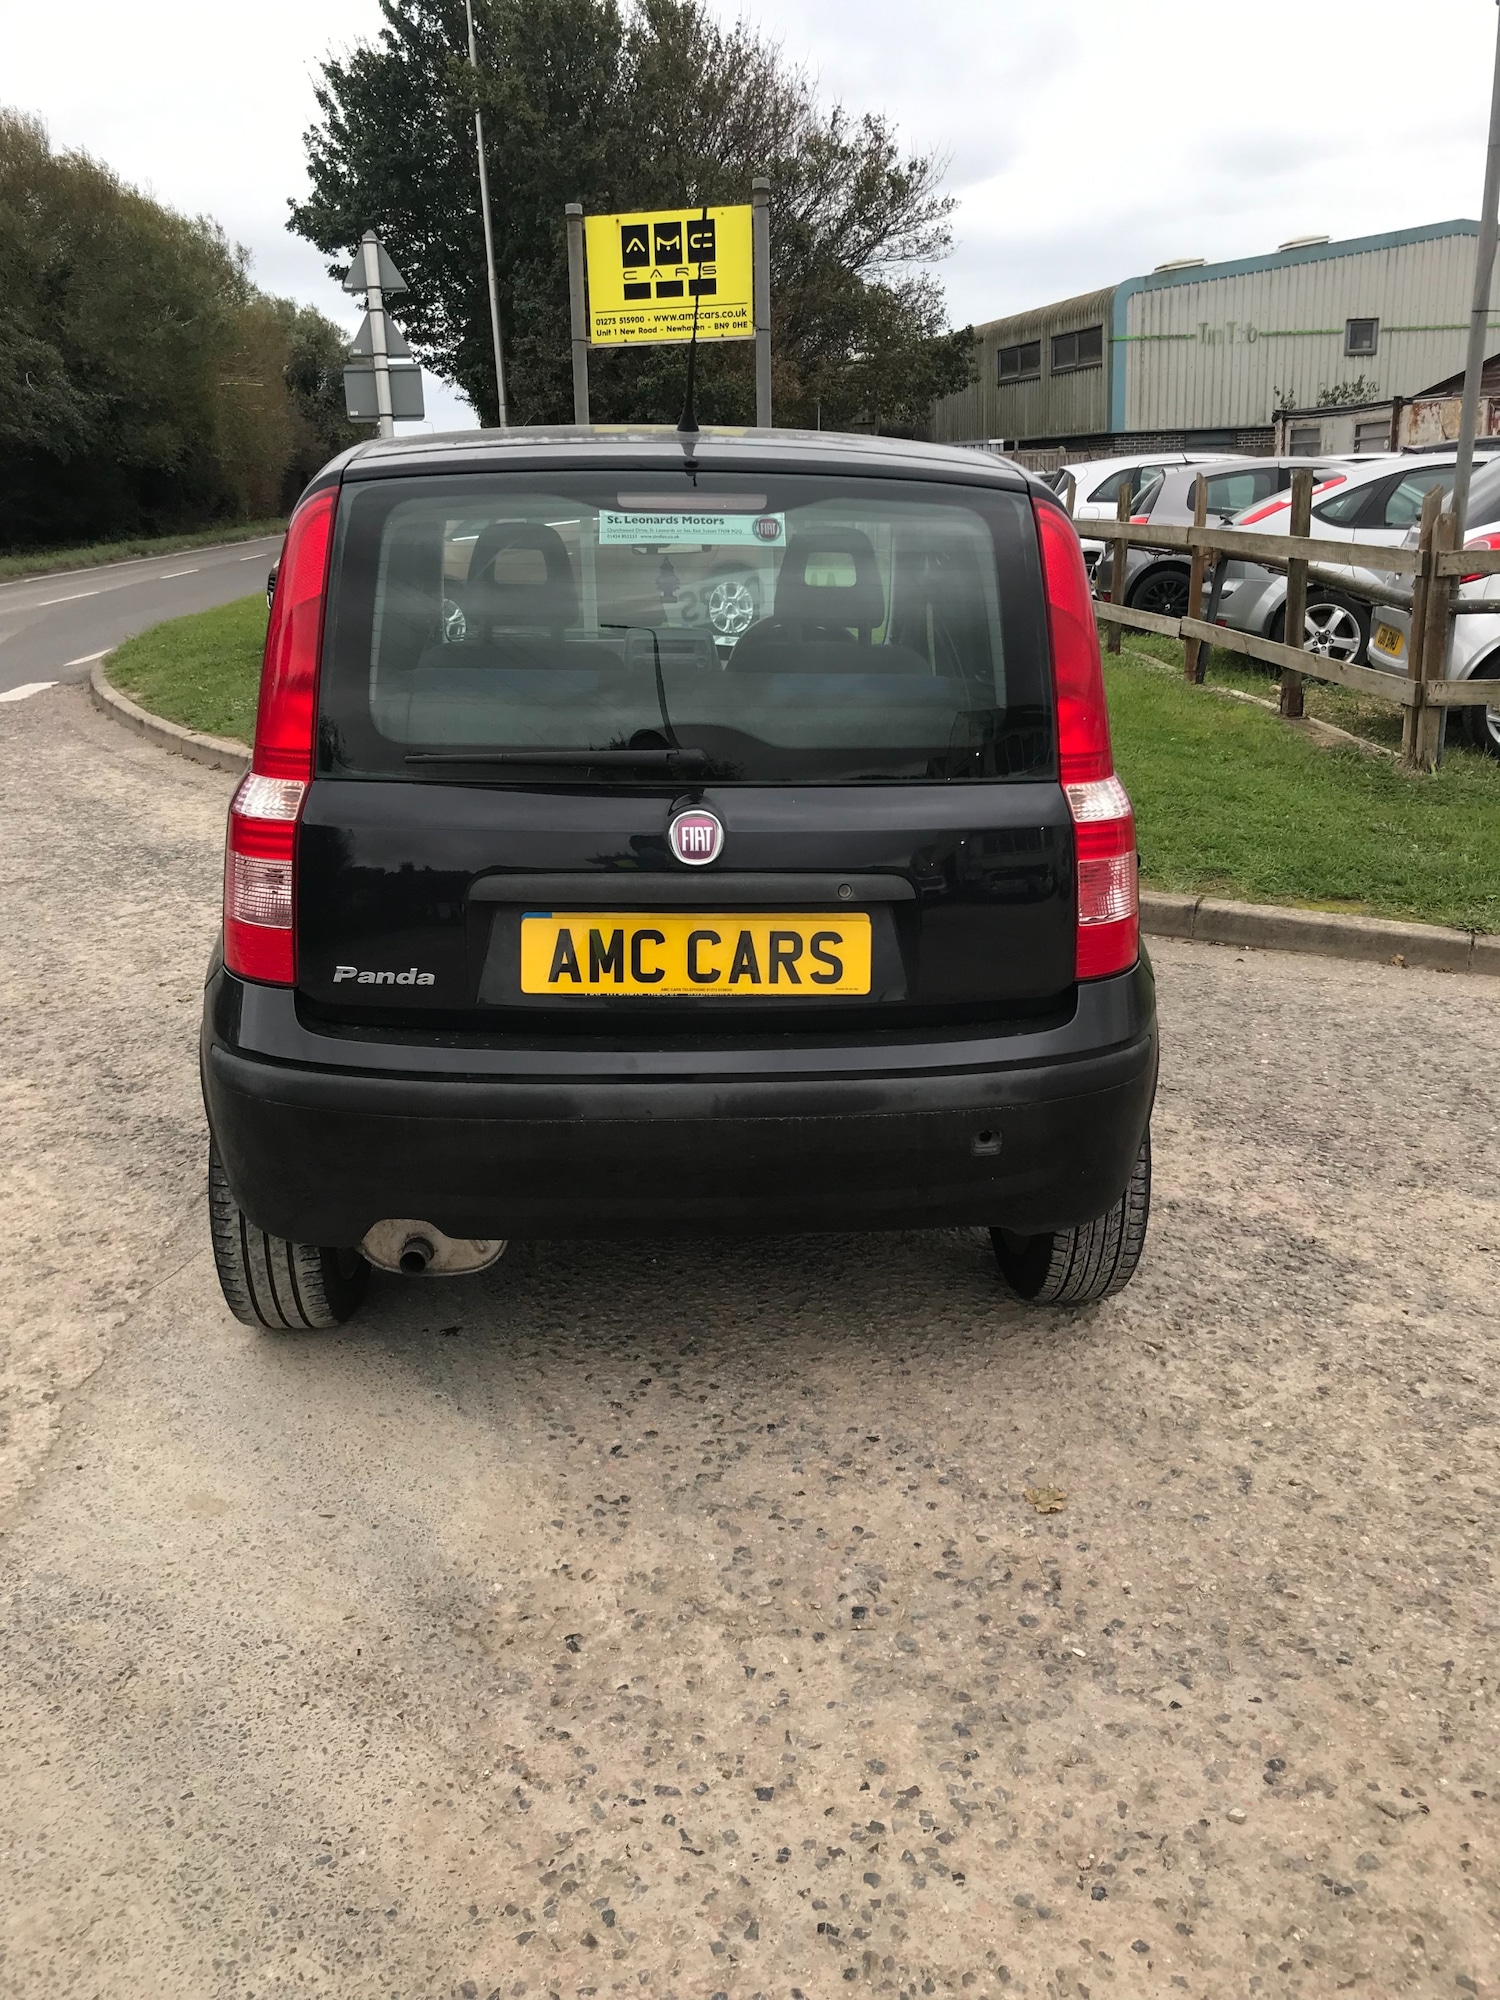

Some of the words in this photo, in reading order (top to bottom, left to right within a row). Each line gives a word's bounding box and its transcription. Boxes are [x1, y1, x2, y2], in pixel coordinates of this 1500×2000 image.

[626, 232, 713, 254] AMC
[623, 265, 717, 281] CARS
[595, 317, 617, 326] 01273
[619, 316, 645, 325] 515900
[596, 329, 611, 337] Unit
[638, 326, 657, 334] Road
[714, 322, 730, 330] BN9
[607, 515, 622, 524] St.
[624, 515, 679, 525] Leonards
[682, 516, 725, 525] Motors
[760, 522, 776, 535] FIAT
[681, 826, 714, 852] FIAT
[547, 928, 666, 984] AMC
[687, 929, 844, 985] CARS
[332, 965, 436, 986] Panda
